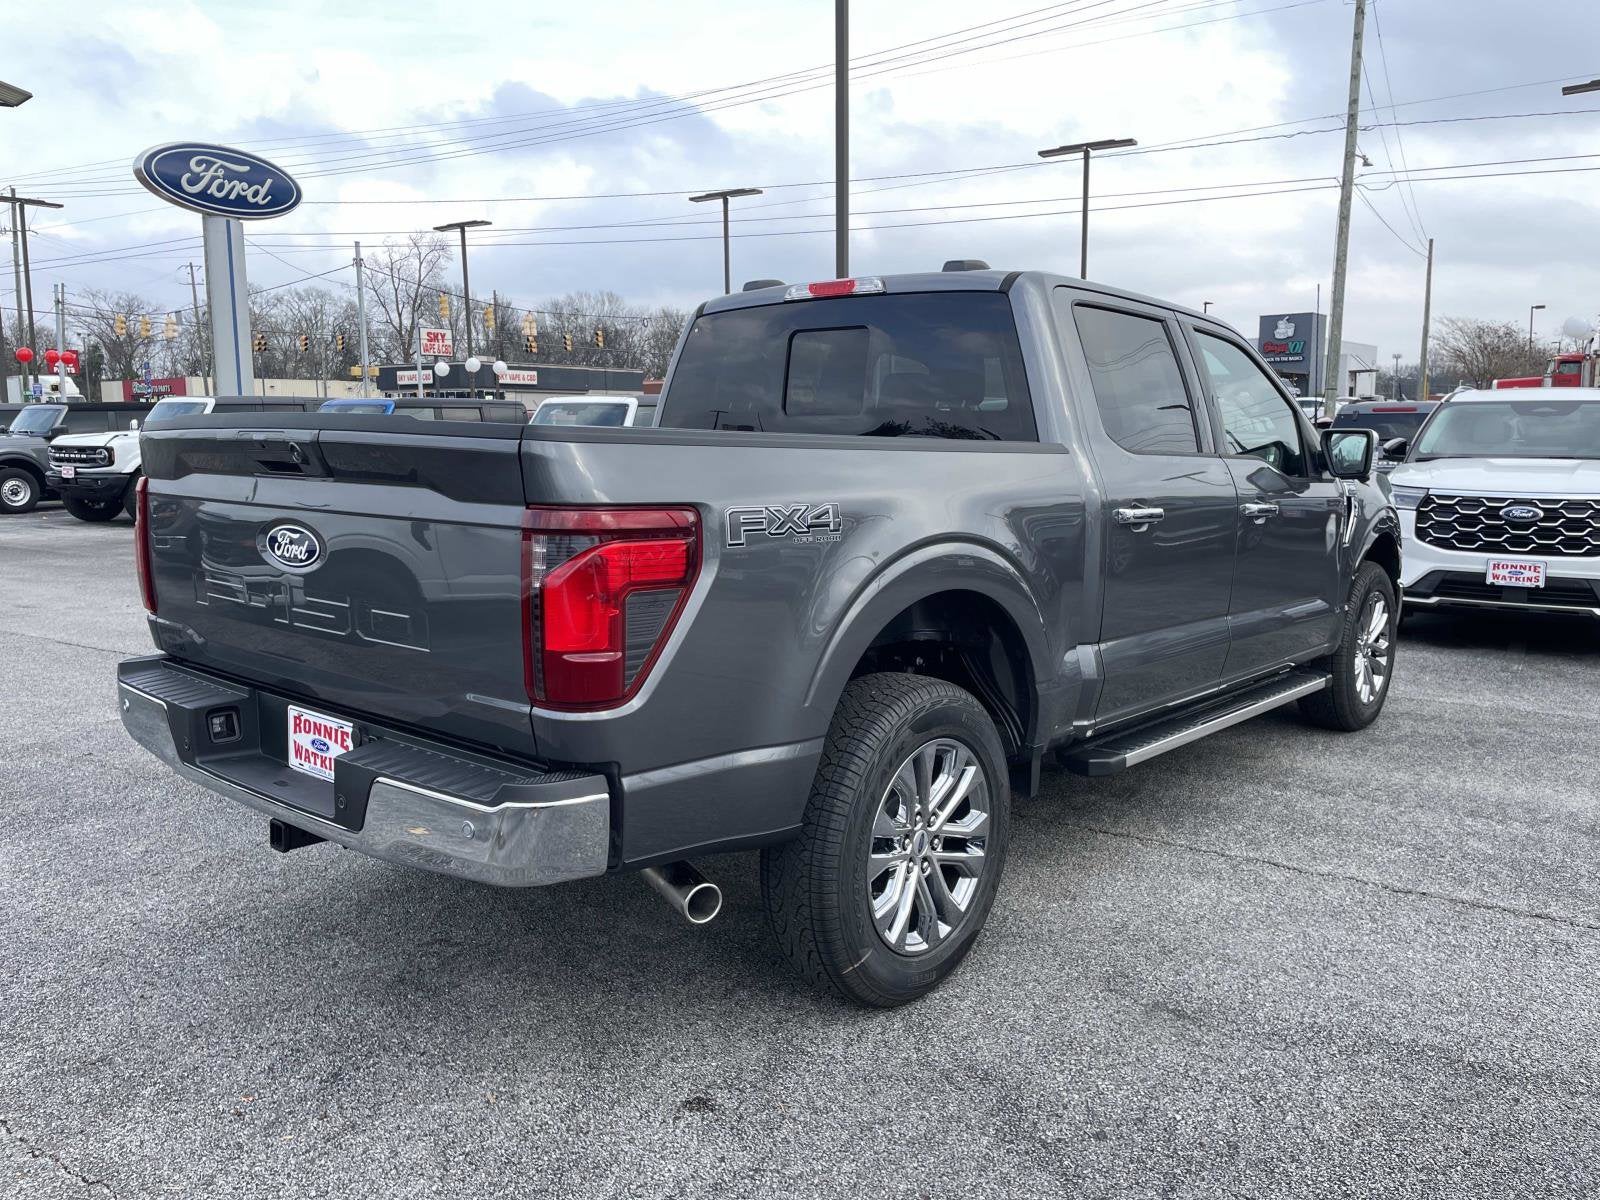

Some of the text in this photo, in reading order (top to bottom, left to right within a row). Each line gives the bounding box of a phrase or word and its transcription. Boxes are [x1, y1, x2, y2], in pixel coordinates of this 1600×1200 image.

[180, 155, 273, 206] Ford
[426, 331, 446, 343] SKY
[422, 343, 452, 355] VAPE & CBD
[398, 373, 431, 382] SKY VAPE CBD
[498, 373, 508, 381] SKY
[509, 374, 521, 382] VAPE
[725, 503, 842, 548] FX4
[274, 530, 309, 560] Ford
[1492, 563, 1541, 573] RONNIE
[1492, 573, 1540, 583] WATKINS
[293, 715, 350, 752] RONNIE
[312, 740, 328, 751] Ford
[293, 739, 334, 771] WATKI
